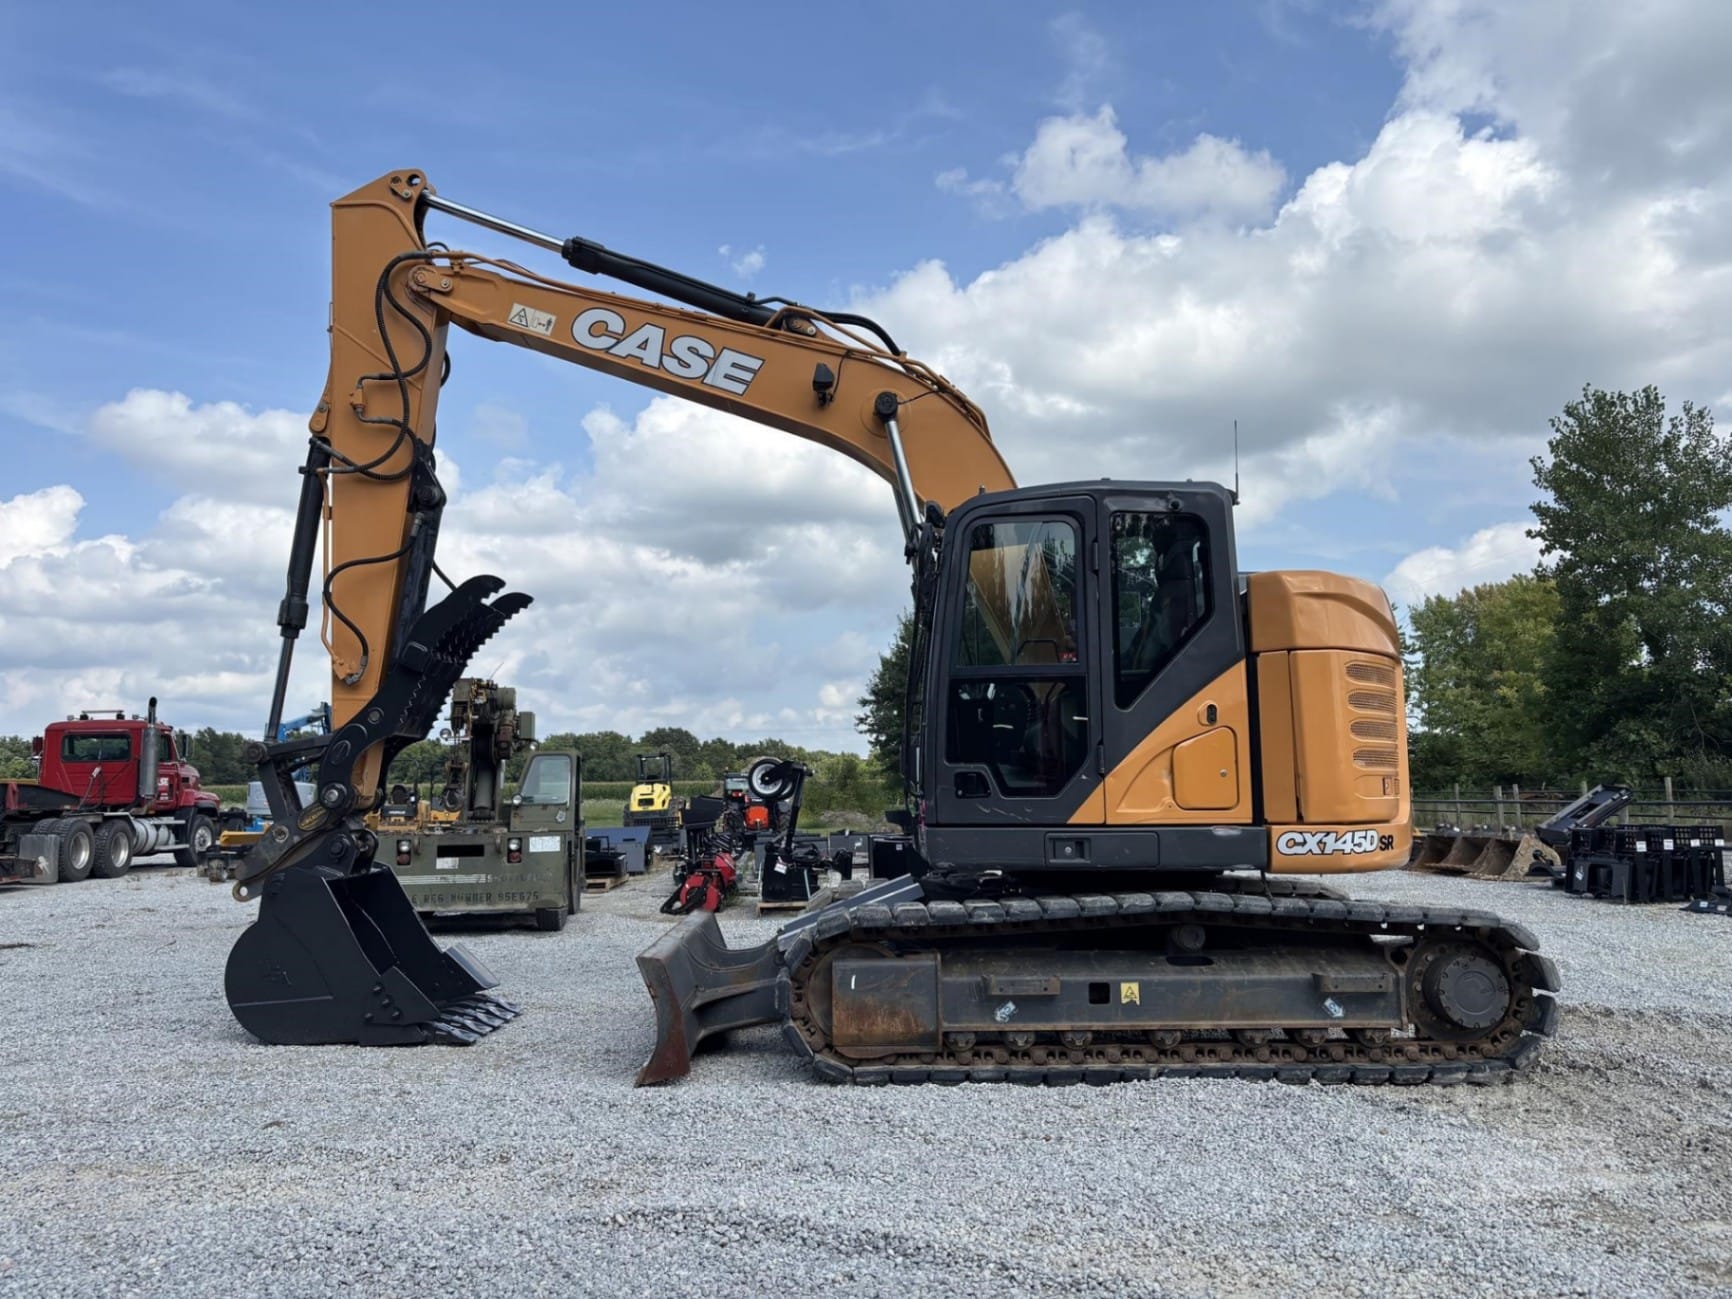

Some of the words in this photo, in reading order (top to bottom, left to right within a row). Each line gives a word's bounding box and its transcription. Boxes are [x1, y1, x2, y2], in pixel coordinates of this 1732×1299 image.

[571, 307, 765, 396] CASE
[1276, 829, 1379, 856] CX145D
[1379, 835, 1394, 851] SR
